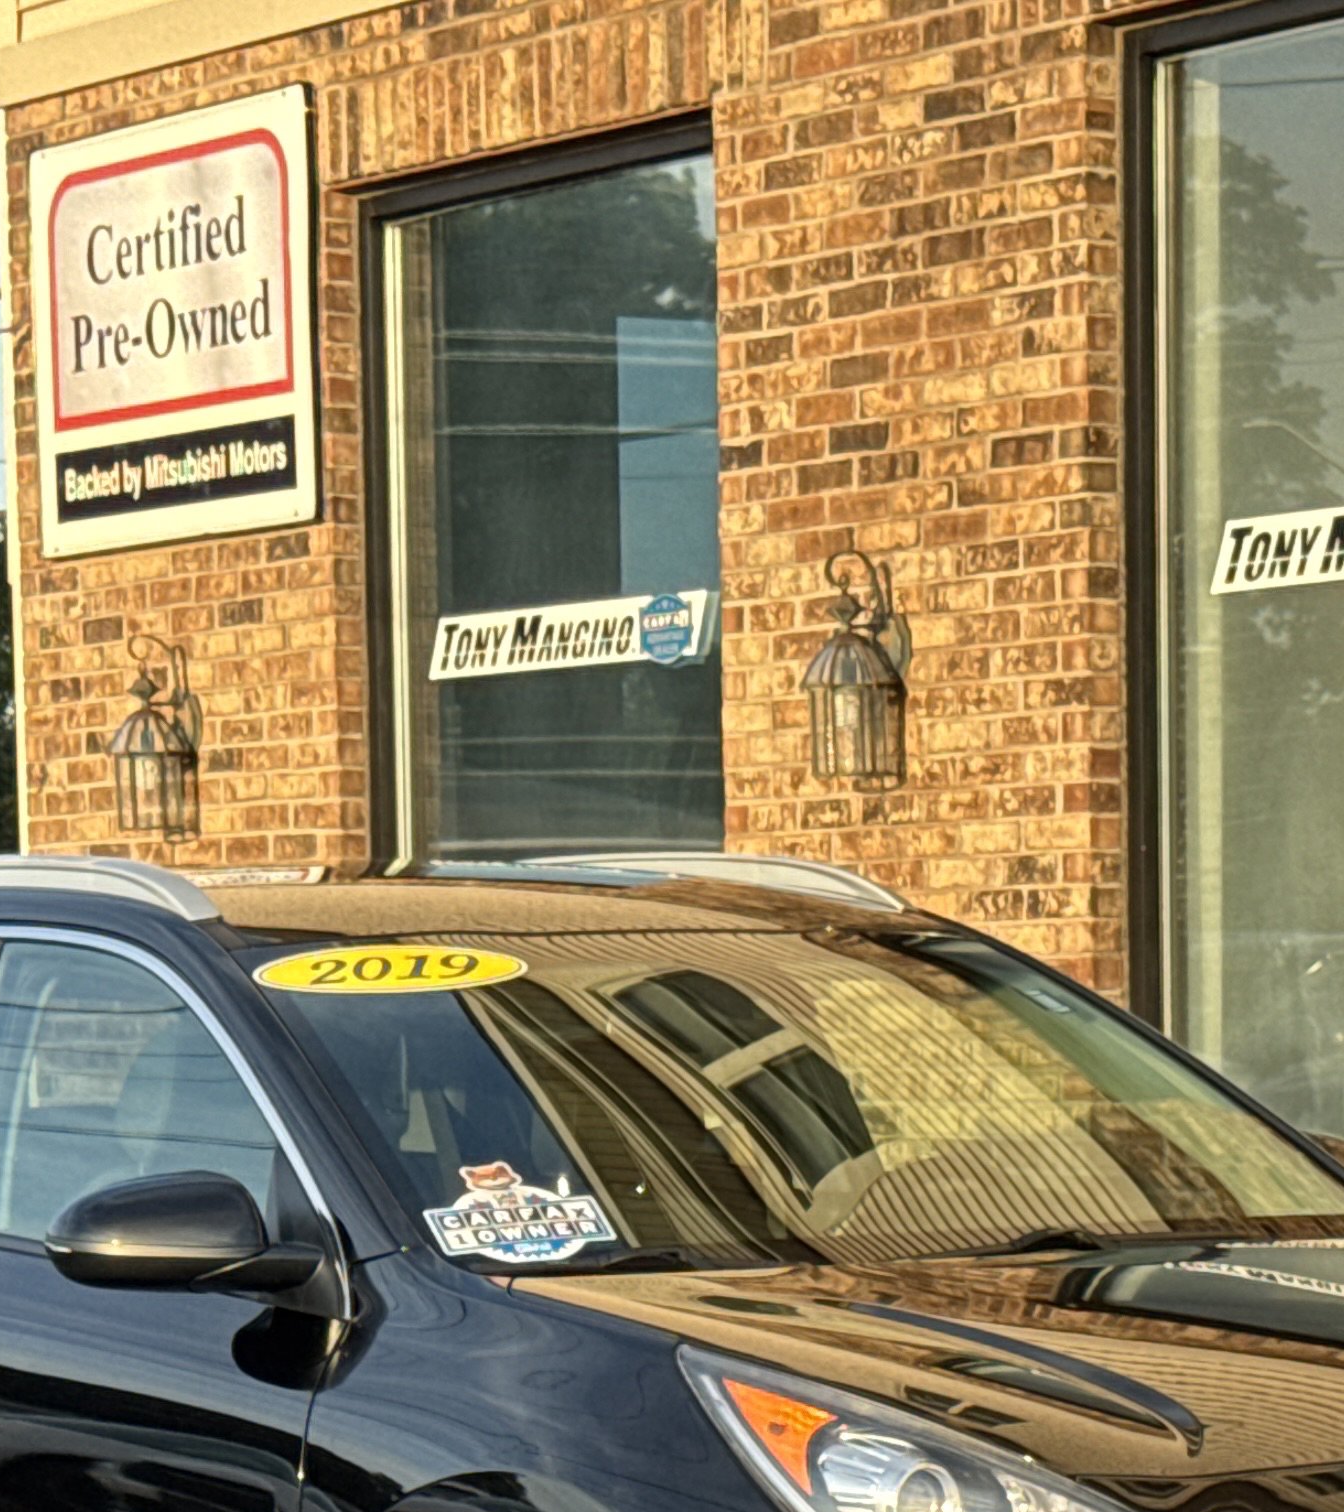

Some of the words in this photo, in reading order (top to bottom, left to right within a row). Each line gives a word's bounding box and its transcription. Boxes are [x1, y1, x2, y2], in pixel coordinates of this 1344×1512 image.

[86, 195, 246, 285] Certified
[72, 278, 272, 375] Pre-Owned
[64, 461, 120, 503] Backed
[122, 459, 142, 501] by
[144, 444, 227, 491] Mitsubishi
[229, 440, 288, 477] Motors
[1223, 525, 1322, 584] TONY
[440, 623, 507, 671] TONY
[309, 953, 480, 987] 2019
[442, 1204, 596, 1230] CARFAX
[477, 1221, 601, 1244] OWNER
